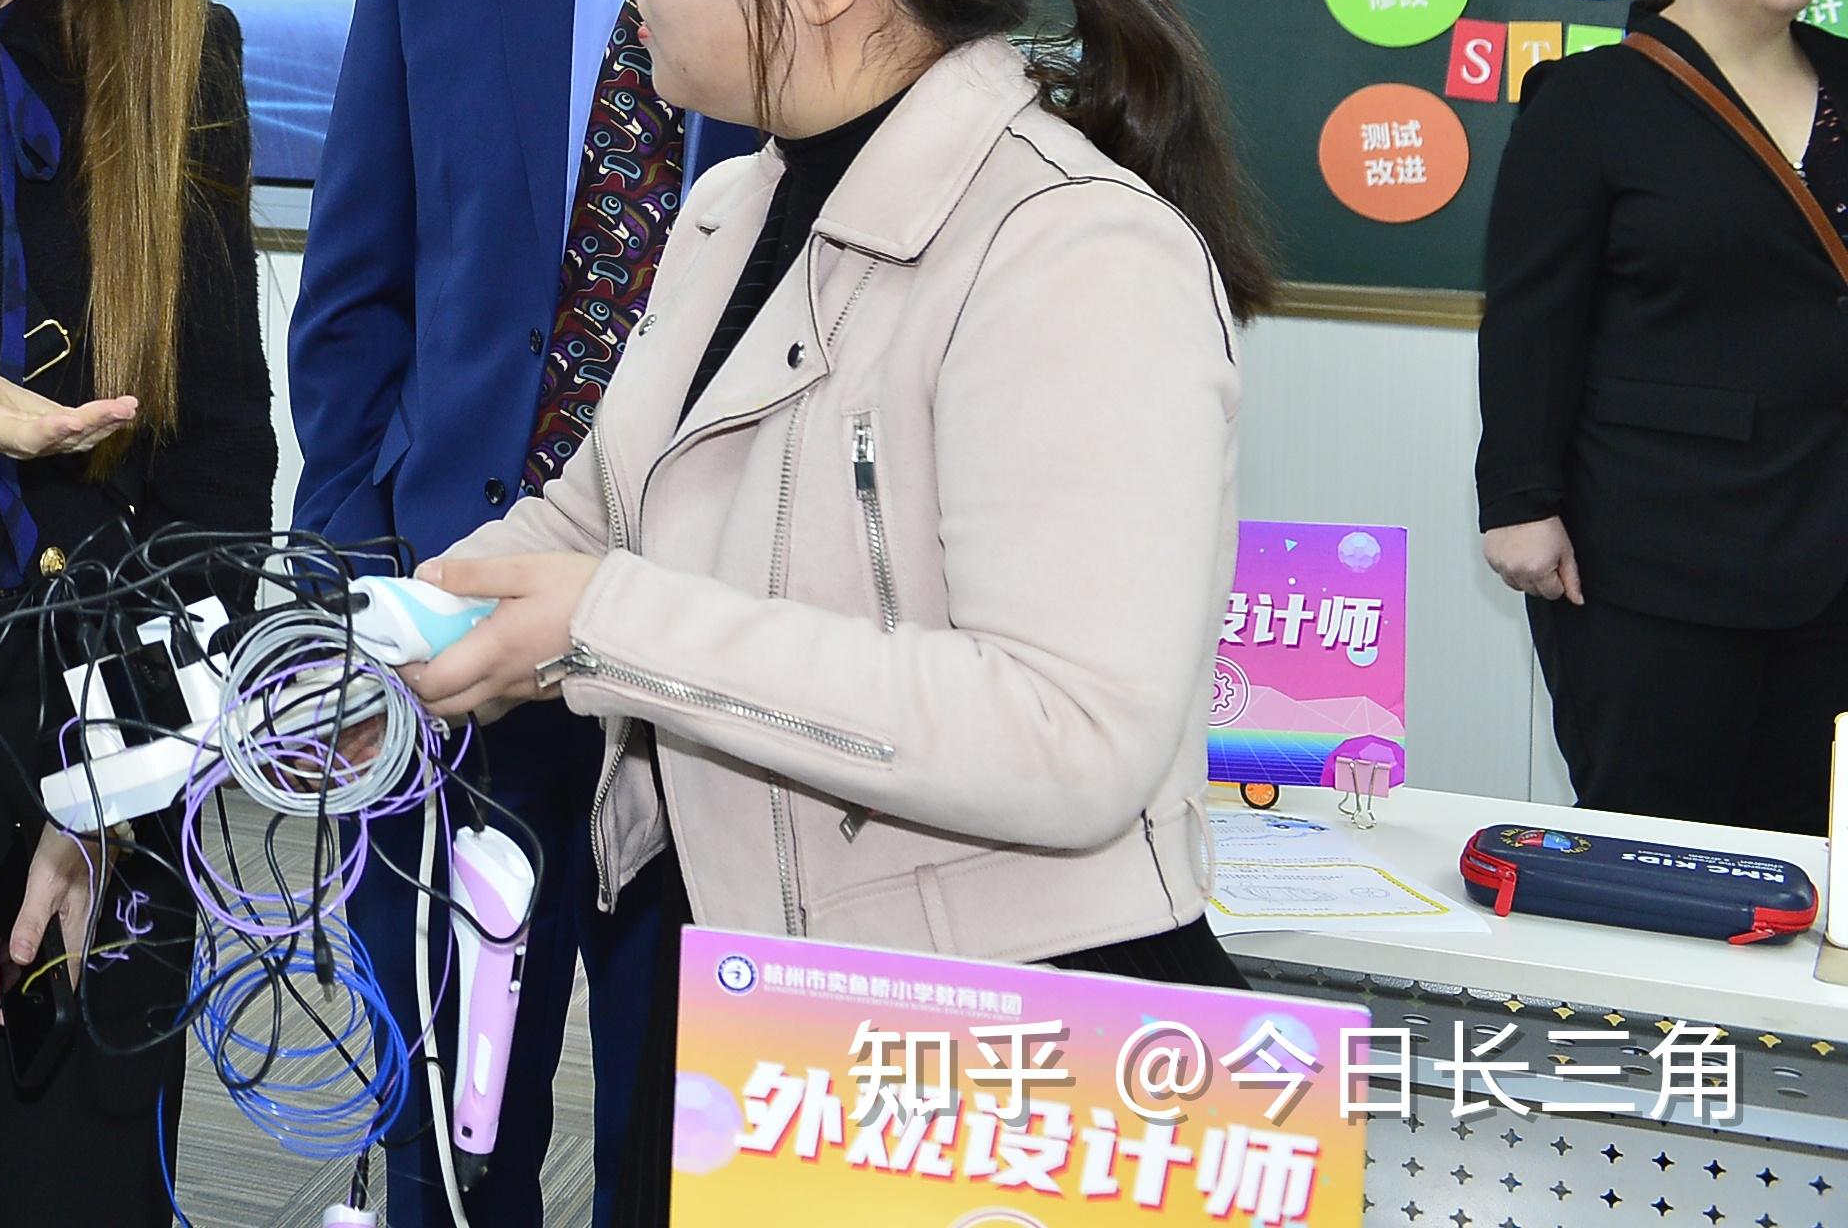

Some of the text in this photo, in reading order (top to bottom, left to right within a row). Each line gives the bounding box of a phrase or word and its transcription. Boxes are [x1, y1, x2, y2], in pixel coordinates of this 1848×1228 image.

[1360, 120, 1424, 152] 测试
[1364, 158, 1428, 187] 改进
[1706, 864, 1785, 883] KMC
[735, 1060, 1323, 1225] 外观设计师
